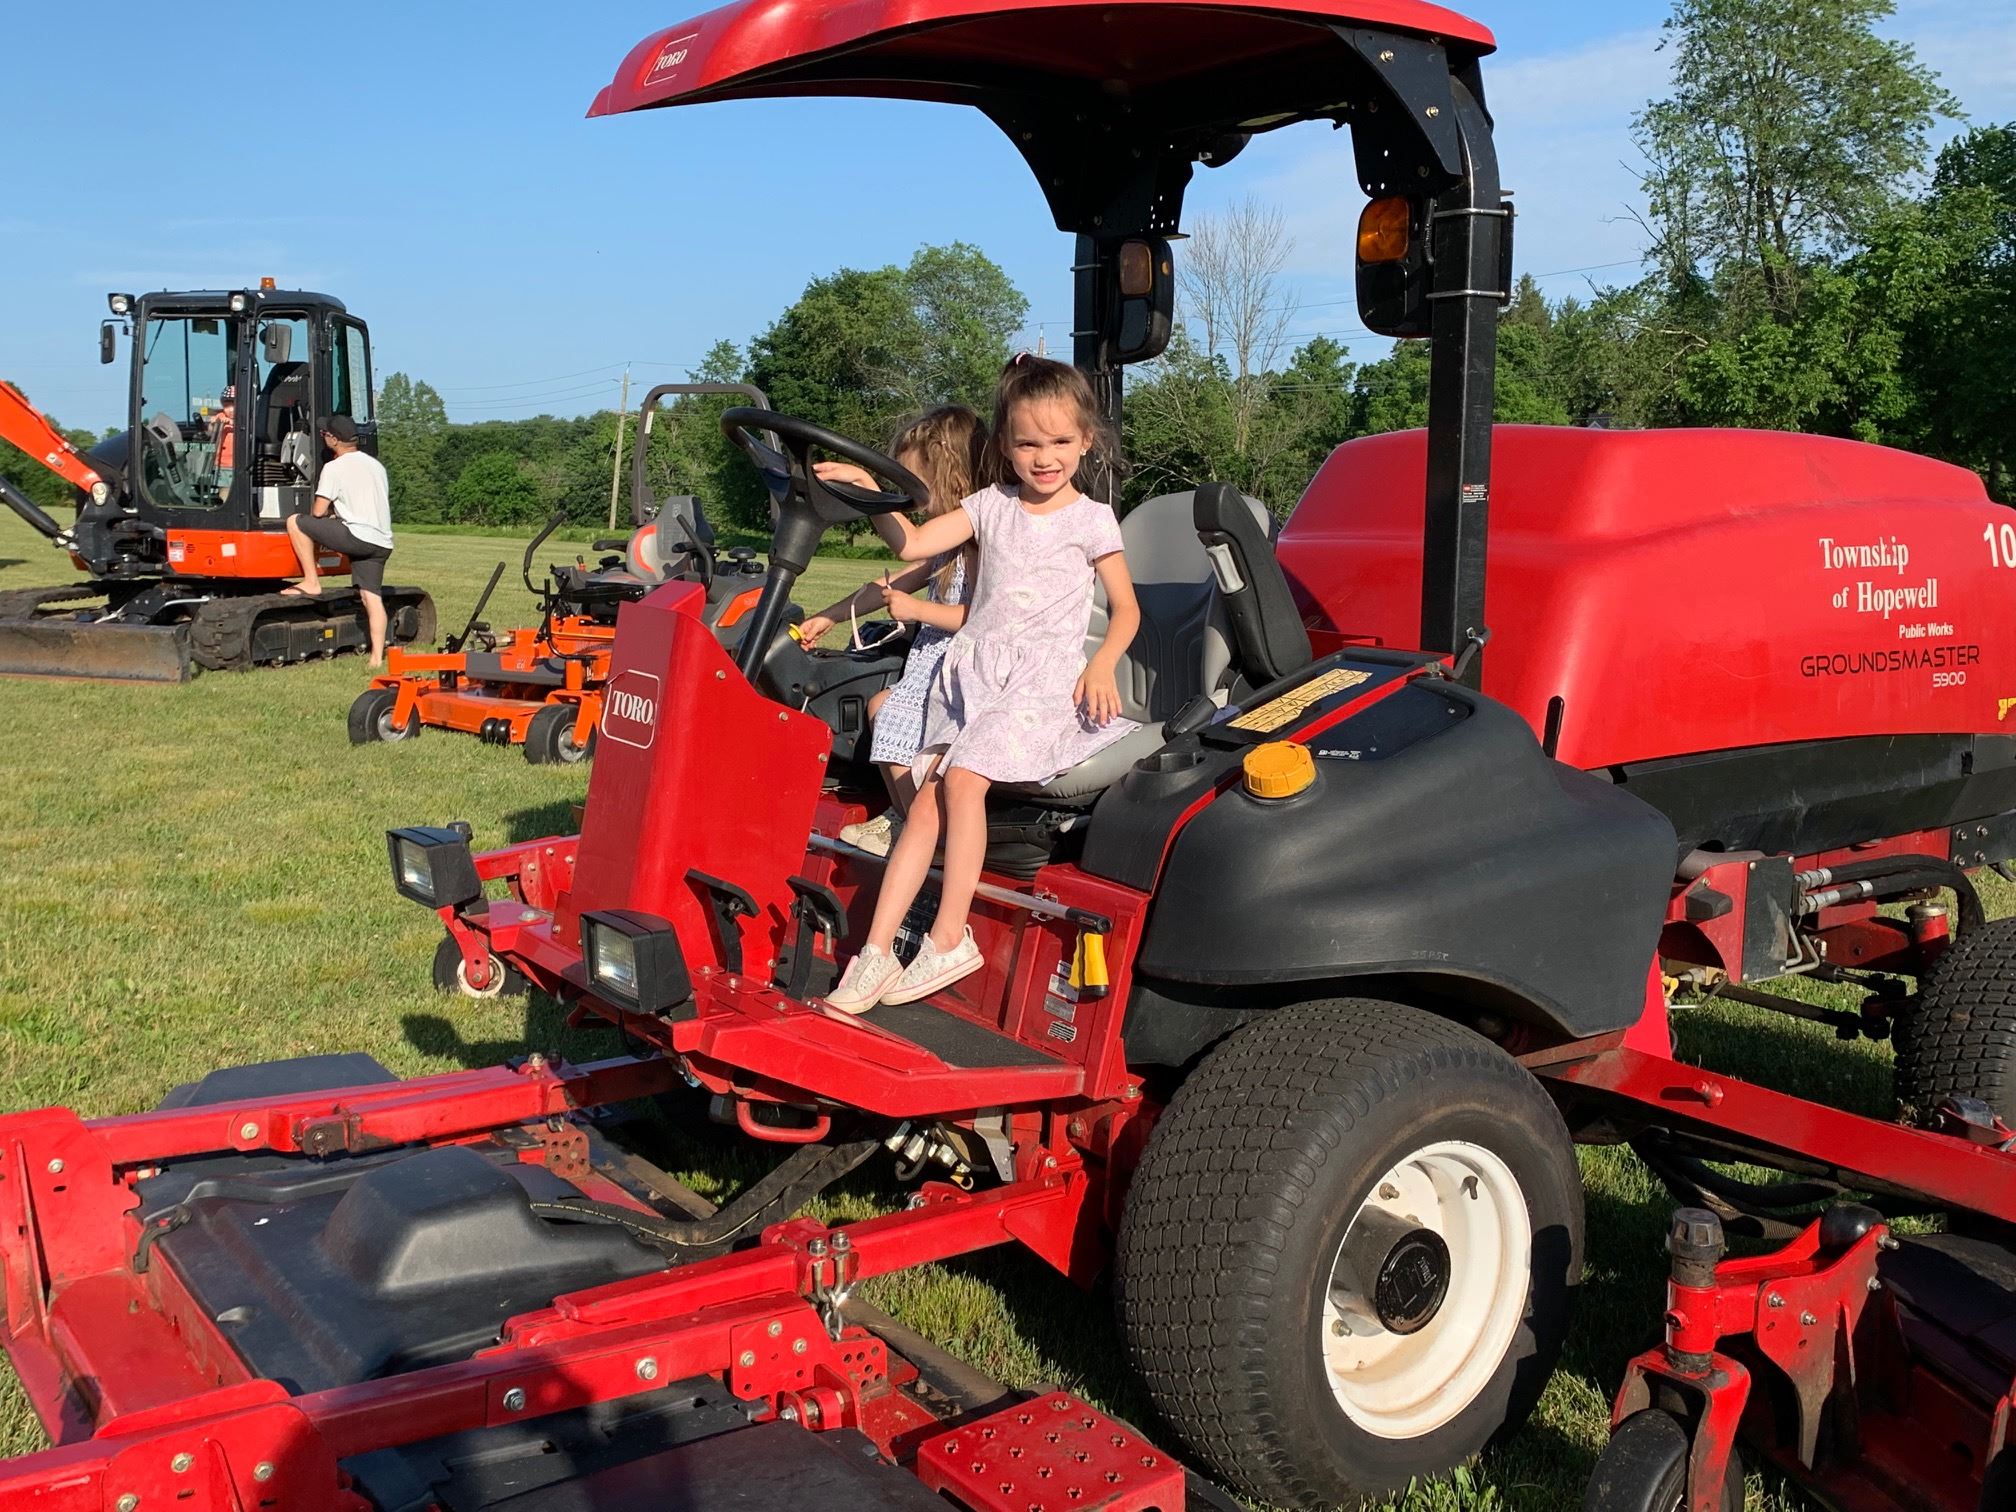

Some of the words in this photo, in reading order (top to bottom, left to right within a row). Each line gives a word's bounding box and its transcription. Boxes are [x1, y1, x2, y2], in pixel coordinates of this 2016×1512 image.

[653, 48, 688, 71] TORO
[1819, 536, 1909, 575] Township
[1833, 587, 1849, 608] of
[1857, 578, 1938, 619] Hopewell
[1899, 623, 1926, 639] Public
[1928, 622, 1954, 636] Works
[1801, 645, 1980, 678] GROUNDSMASTER
[1933, 671, 1967, 688] 5900
[612, 690, 654, 724] TORO
